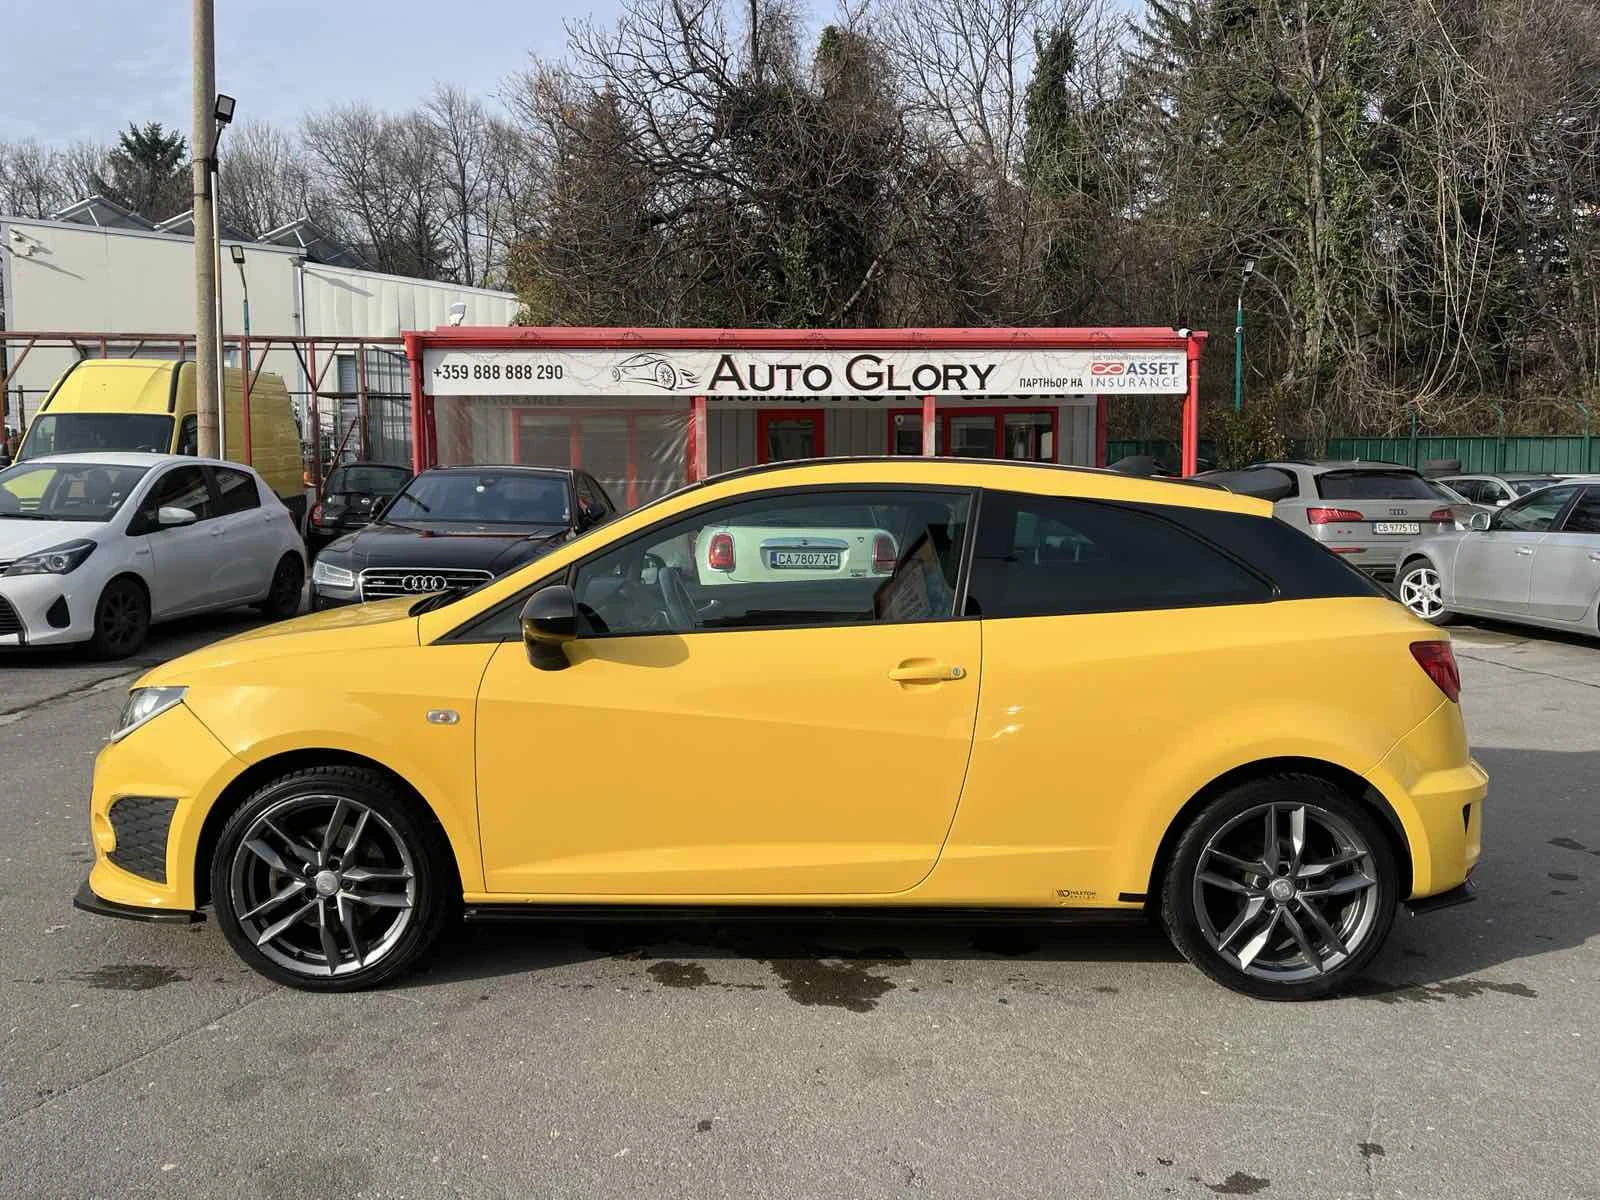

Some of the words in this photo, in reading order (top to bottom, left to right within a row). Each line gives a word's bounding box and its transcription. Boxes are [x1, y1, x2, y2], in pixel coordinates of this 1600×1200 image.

[433, 364, 469, 380] +359
[474, 364, 501, 380] 888
[505, 364, 532, 380] 888
[537, 364, 563, 380] 290
[707, 353, 833, 392] AUTO
[845, 353, 997, 392] GLORY
[1126, 362, 1179, 376] ASSET
[1019, 377, 1068, 388] ПАРТНЬОР
[1070, 377, 1083, 388] НА
[1090, 377, 1179, 388] INSURANCE
[778, 553, 793, 565] CA
[794, 553, 821, 565] 7807
[822, 553, 837, 565] XP
